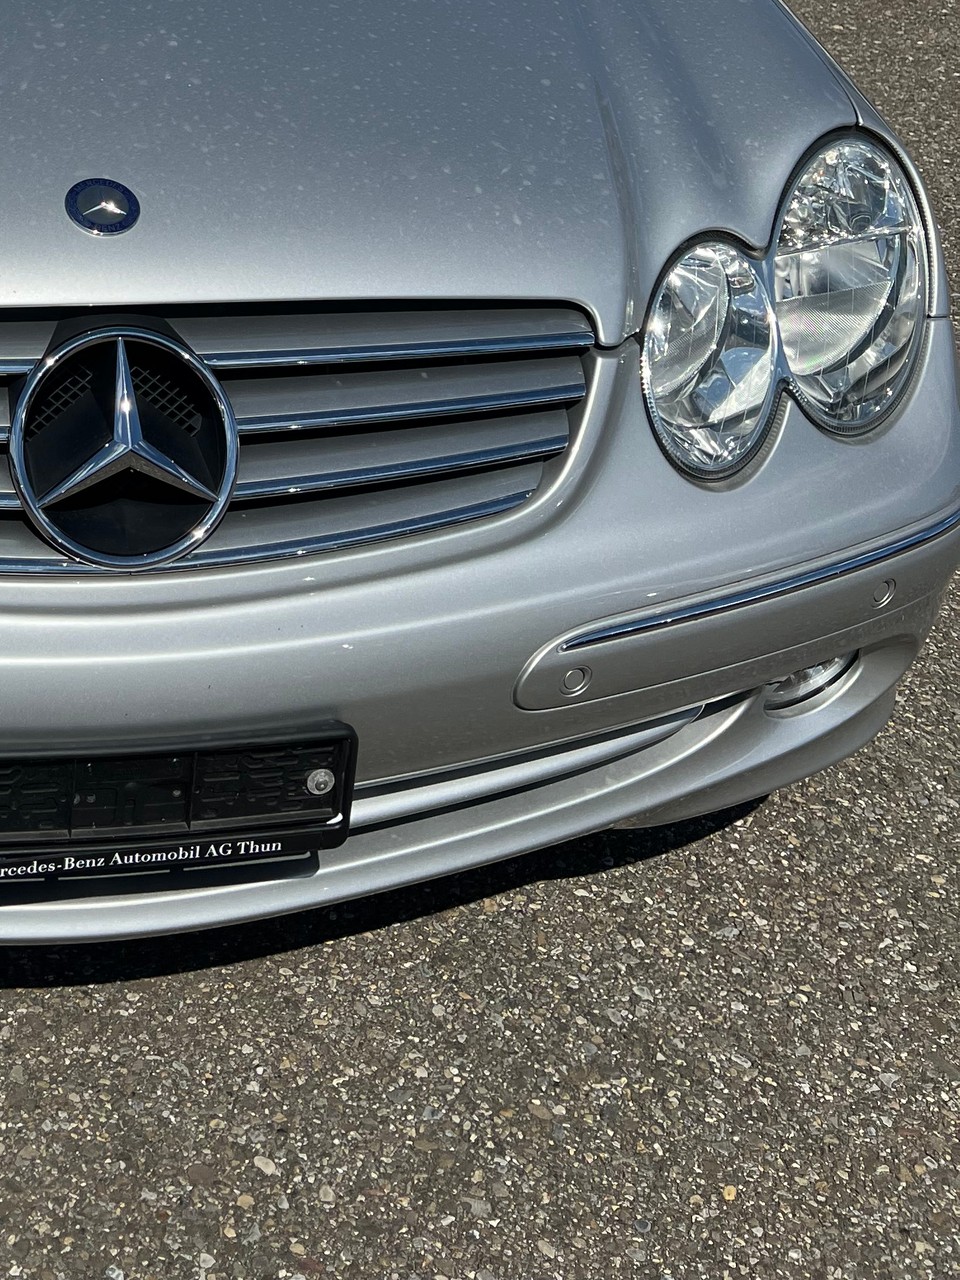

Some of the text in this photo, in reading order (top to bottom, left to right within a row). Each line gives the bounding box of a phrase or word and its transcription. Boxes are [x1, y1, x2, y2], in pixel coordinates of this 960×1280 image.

[108, 845, 201, 866] Automobil
[204, 842, 233, 858] AG
[236, 840, 282, 856] Thun
